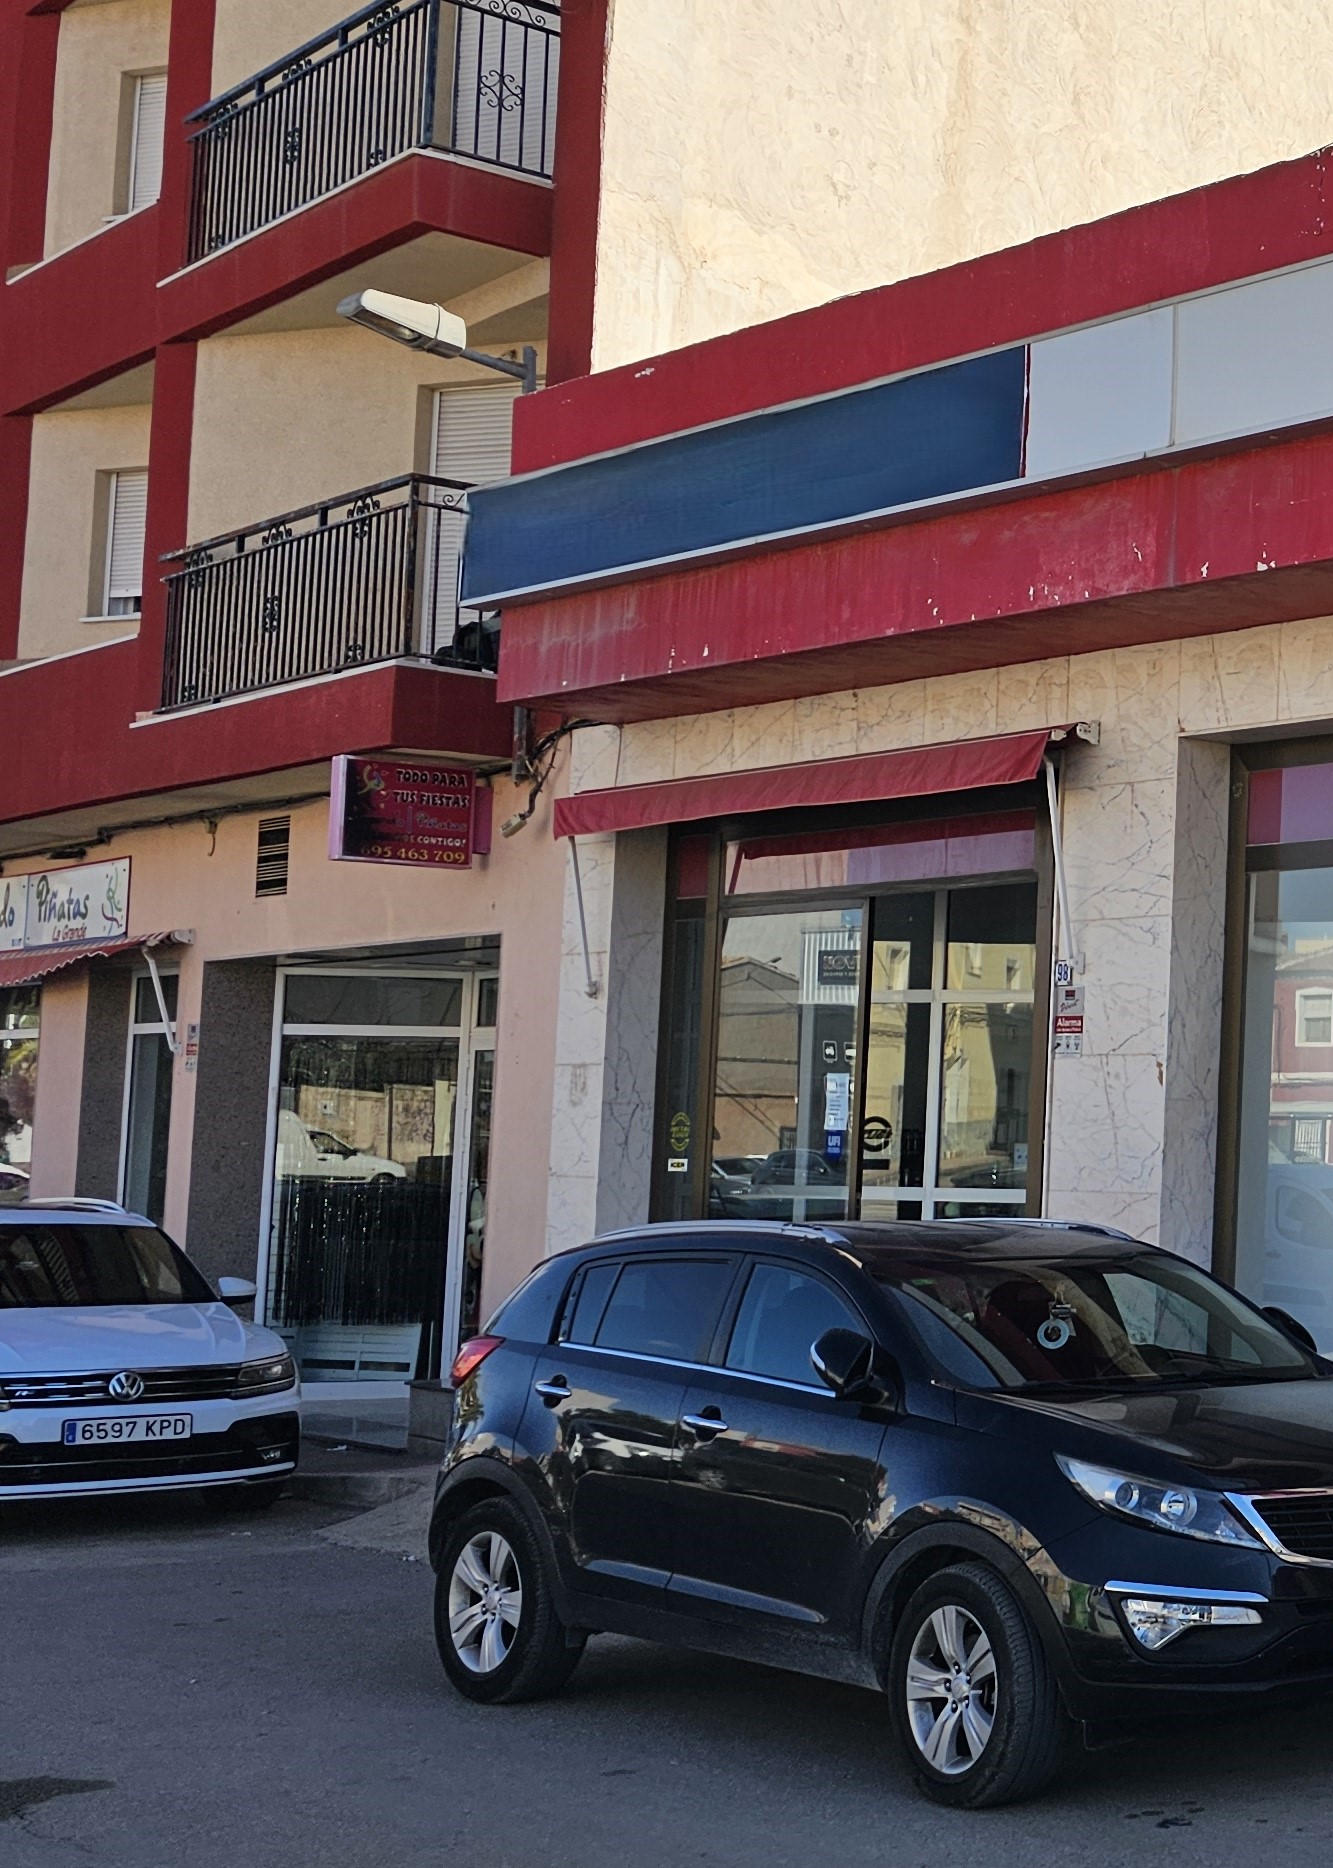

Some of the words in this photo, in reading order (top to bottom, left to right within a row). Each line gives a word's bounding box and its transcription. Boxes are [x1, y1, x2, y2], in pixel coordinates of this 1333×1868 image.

[396, 769, 428, 785] TODO
[431, 773, 467, 788] PARA
[393, 790, 417, 804] TUS
[420, 792, 469, 808] FIESTAS
[417, 834, 466, 847] CONTIGO!
[360, 844, 392, 857] 695
[396, 848, 428, 861] 463
[434, 850, 465, 864] 709
[36, 874, 90, 924] Piñatas
[1057, 963, 1069, 981] 98
[81, 1421, 137, 1441] 6597
[145, 1418, 186, 1437] KPD
